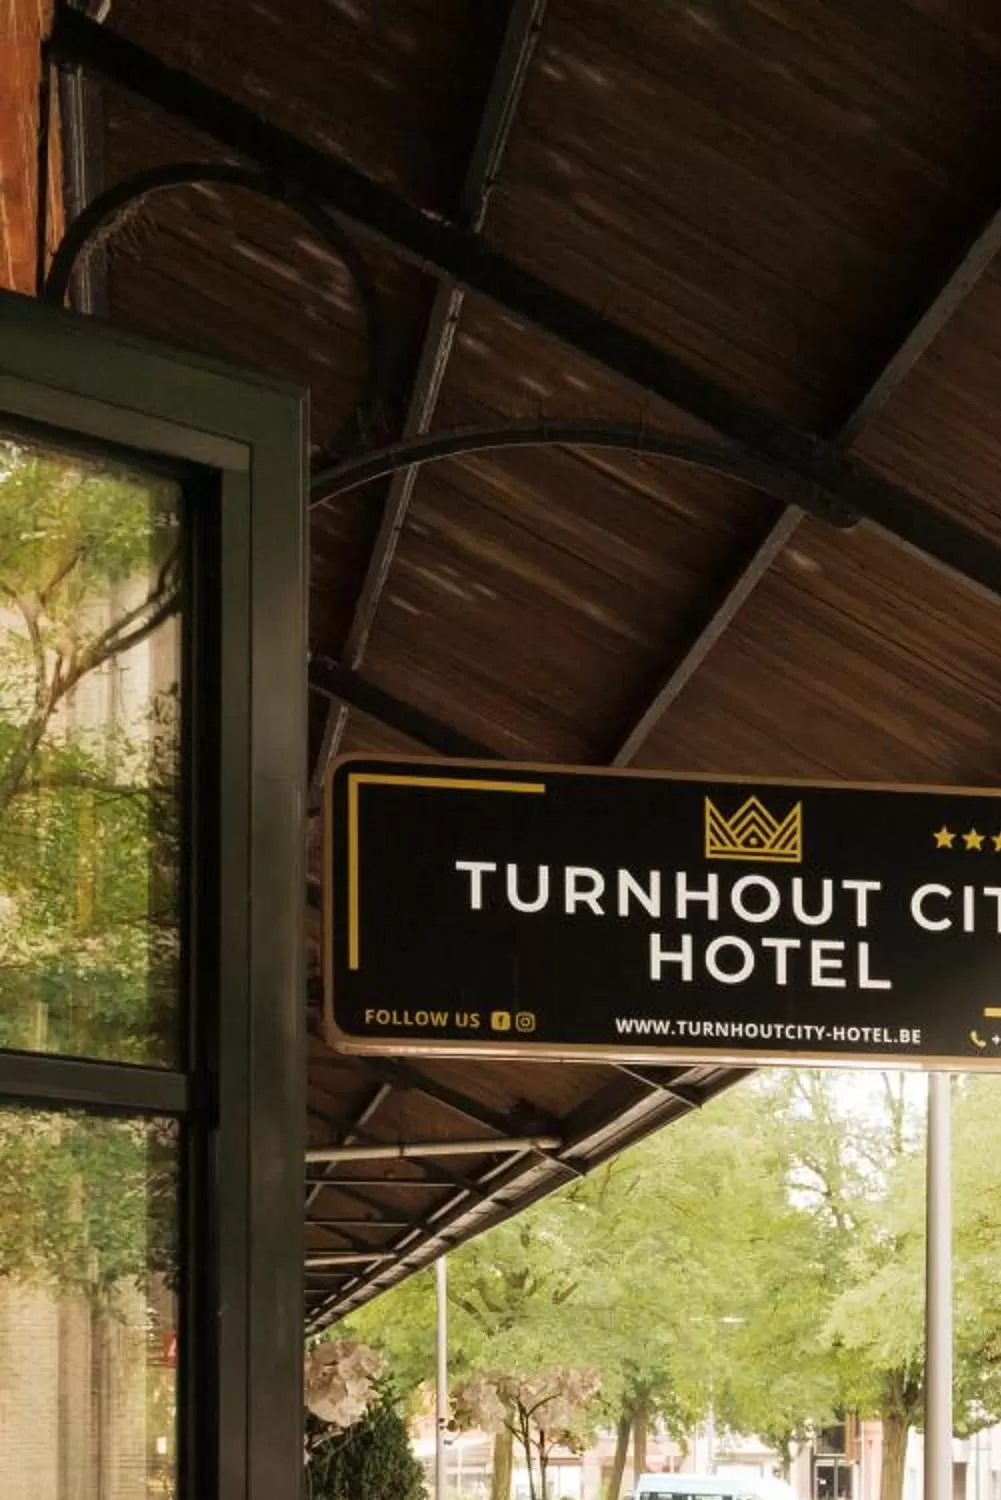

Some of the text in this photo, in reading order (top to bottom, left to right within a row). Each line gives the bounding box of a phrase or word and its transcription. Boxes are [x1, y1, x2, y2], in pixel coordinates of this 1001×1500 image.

[455, 861, 881, 928] TURNHOUT
[649, 933, 892, 990] HOTEL
[364, 1009, 481, 1028] FOLLOW US
[615, 1017, 922, 1045] WWW.TURNHOUTCITY-HOTEL.BE
